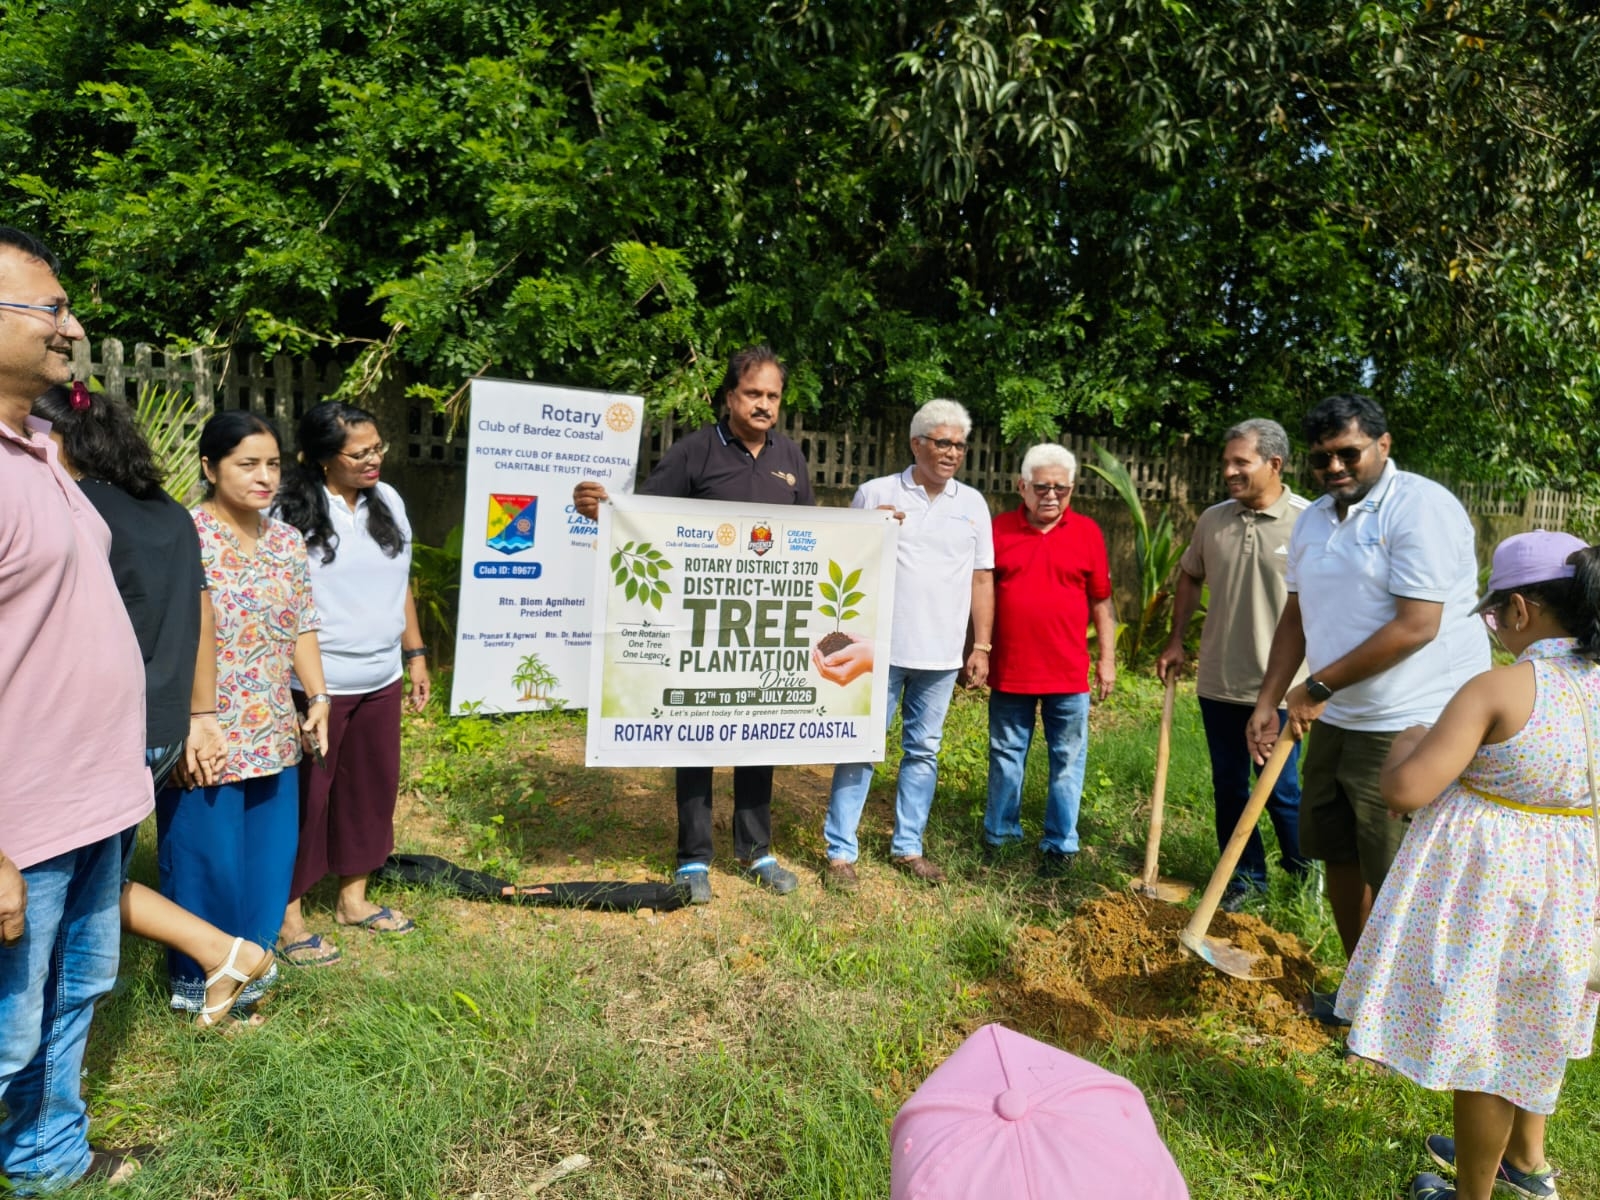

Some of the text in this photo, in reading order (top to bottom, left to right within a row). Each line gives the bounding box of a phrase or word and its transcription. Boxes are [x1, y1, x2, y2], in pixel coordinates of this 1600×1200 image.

[542, 404, 601, 428] Rotary
[478, 420, 604, 441] Club of Bardez Coastal
[476, 446, 631, 466] ROTARY CLUB OF BARDEZ COASTAL
[495, 461, 612, 478] CHARITABLE TRUST (Regd.)
[569, 526, 598, 536] IMPA
[676, 526, 714, 541] Rotary
[787, 530, 812, 538] CREATE
[479, 566, 537, 575] Club ID: 89677
[684, 558, 818, 576] ROTARY DISTRICT 3170
[683, 577, 814, 598] DISTRICT-WIDE
[499, 597, 586, 608] Rtn. Biom Agnihotri
[520, 608, 562, 618] President
[682, 598, 814, 648] TREE
[621, 629, 671, 640] One Rotarian
[483, 640, 515, 648] Secretary
[628, 640, 662, 649] One Tree
[622, 650, 666, 662] One Legacy
[680, 650, 809, 672] PLANTATION
[758, 668, 808, 691] Drive
[694, 690, 812, 704] 12TH TO 19TH JULY 2026
[670, 709, 689, 718] Let's
[690, 708, 710, 718] plant
[711, 708, 732, 718] today
[734, 708, 744, 716] for
[751, 709, 779, 718] greener
[780, 707, 815, 716] tomorrow!
[614, 721, 858, 742] ROTARY CLUB OF BARDEZ COASTAL
